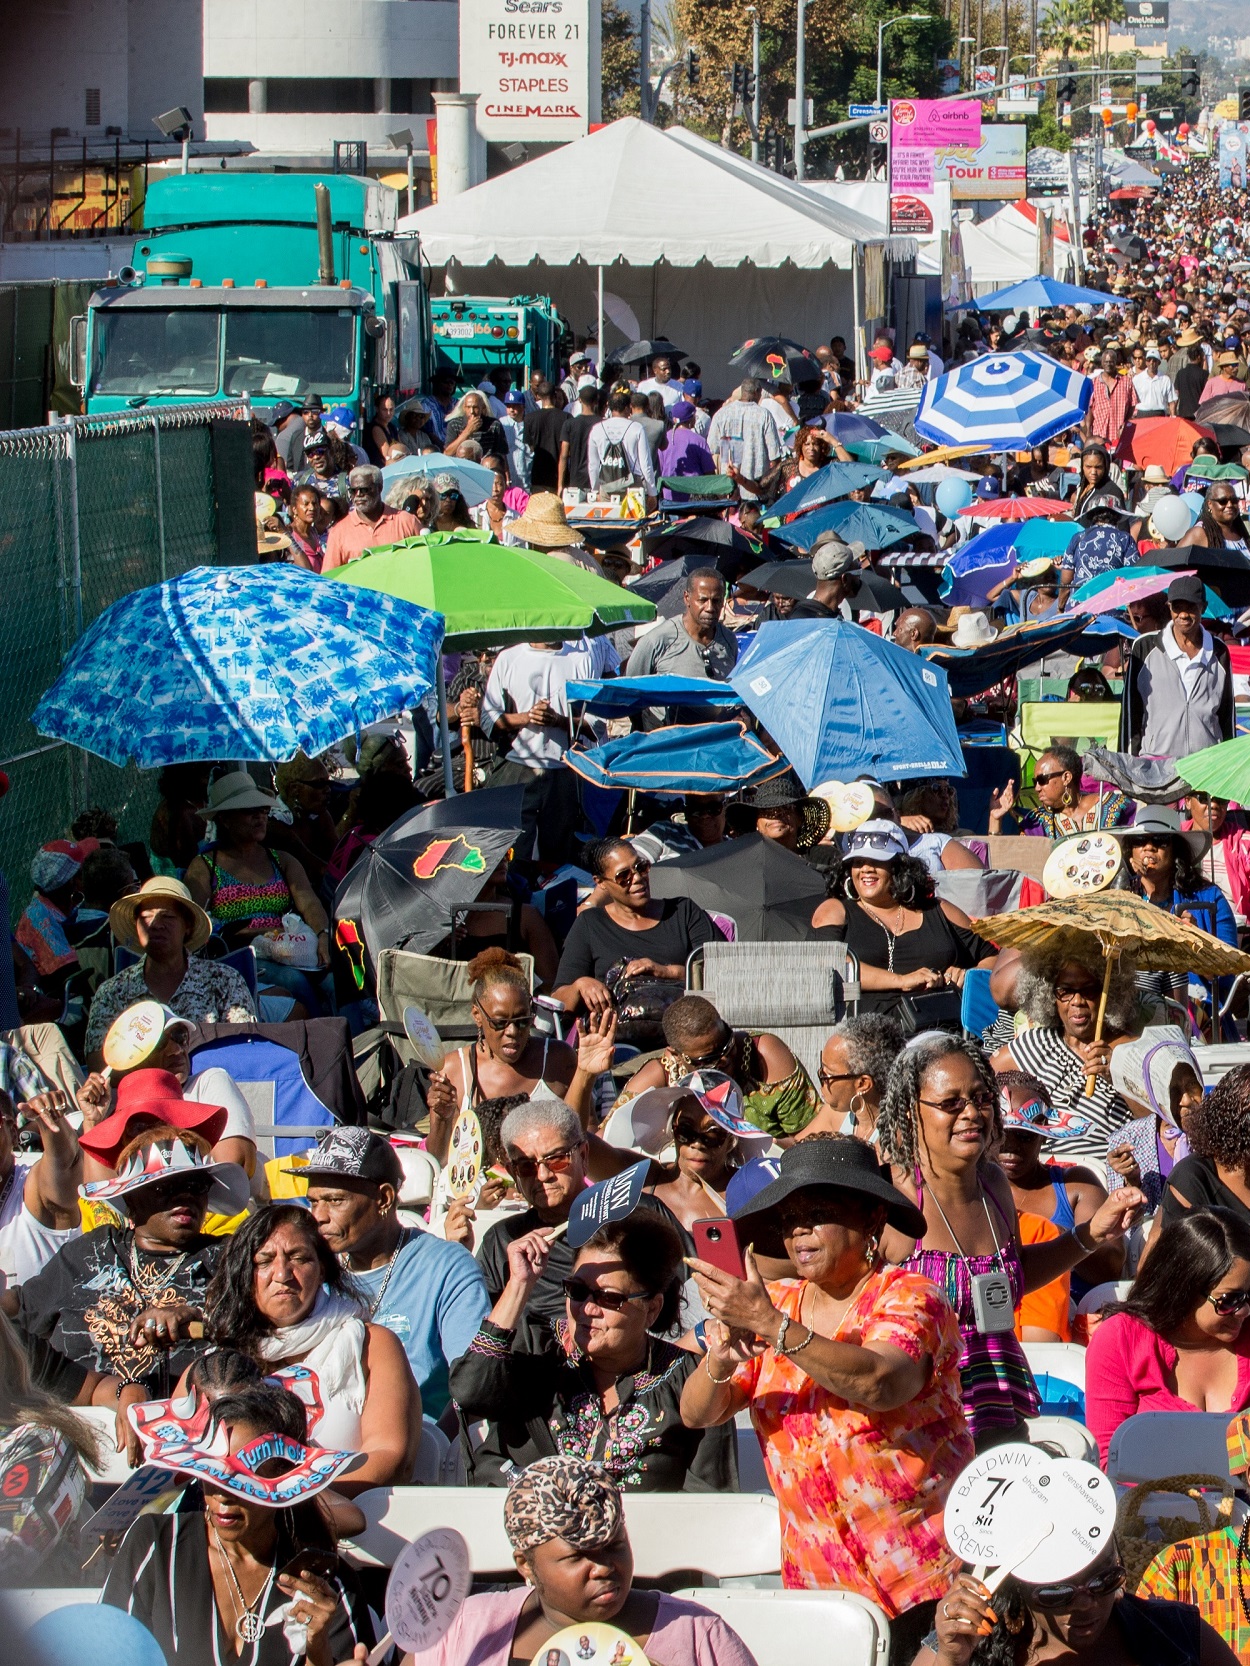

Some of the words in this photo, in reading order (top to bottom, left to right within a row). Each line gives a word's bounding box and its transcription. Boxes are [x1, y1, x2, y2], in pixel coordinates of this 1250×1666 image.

[505, 0, 563, 13] Sears
[1128, 16, 1165, 24] OneUnited
[489, 24, 556, 39] FOREVER
[565, 24, 579, 39] 21
[499, 78, 568, 92] STAPLES
[943, 109, 969, 120] airbnb
[946, 165, 984, 178] Tour
[303, 432, 323, 448] Cali
[602, 456, 624, 468] Jeep
[1019, 1102, 1040, 1119] Turn
[236, 1444, 272, 1470] Turn
[273, 1434, 284, 1456] it
[181, 1450, 349, 1501] bewaterwise.c
[958, 1452, 1032, 1497] BALDWIN
[1022, 1476, 1049, 1504] bhcgram
[1062, 1470, 1105, 1515] crenshawplaza
[953, 1524, 997, 1558] CRENS
[1071, 1528, 1097, 1556] bhcplive
[419, 1554, 452, 1602] 70
